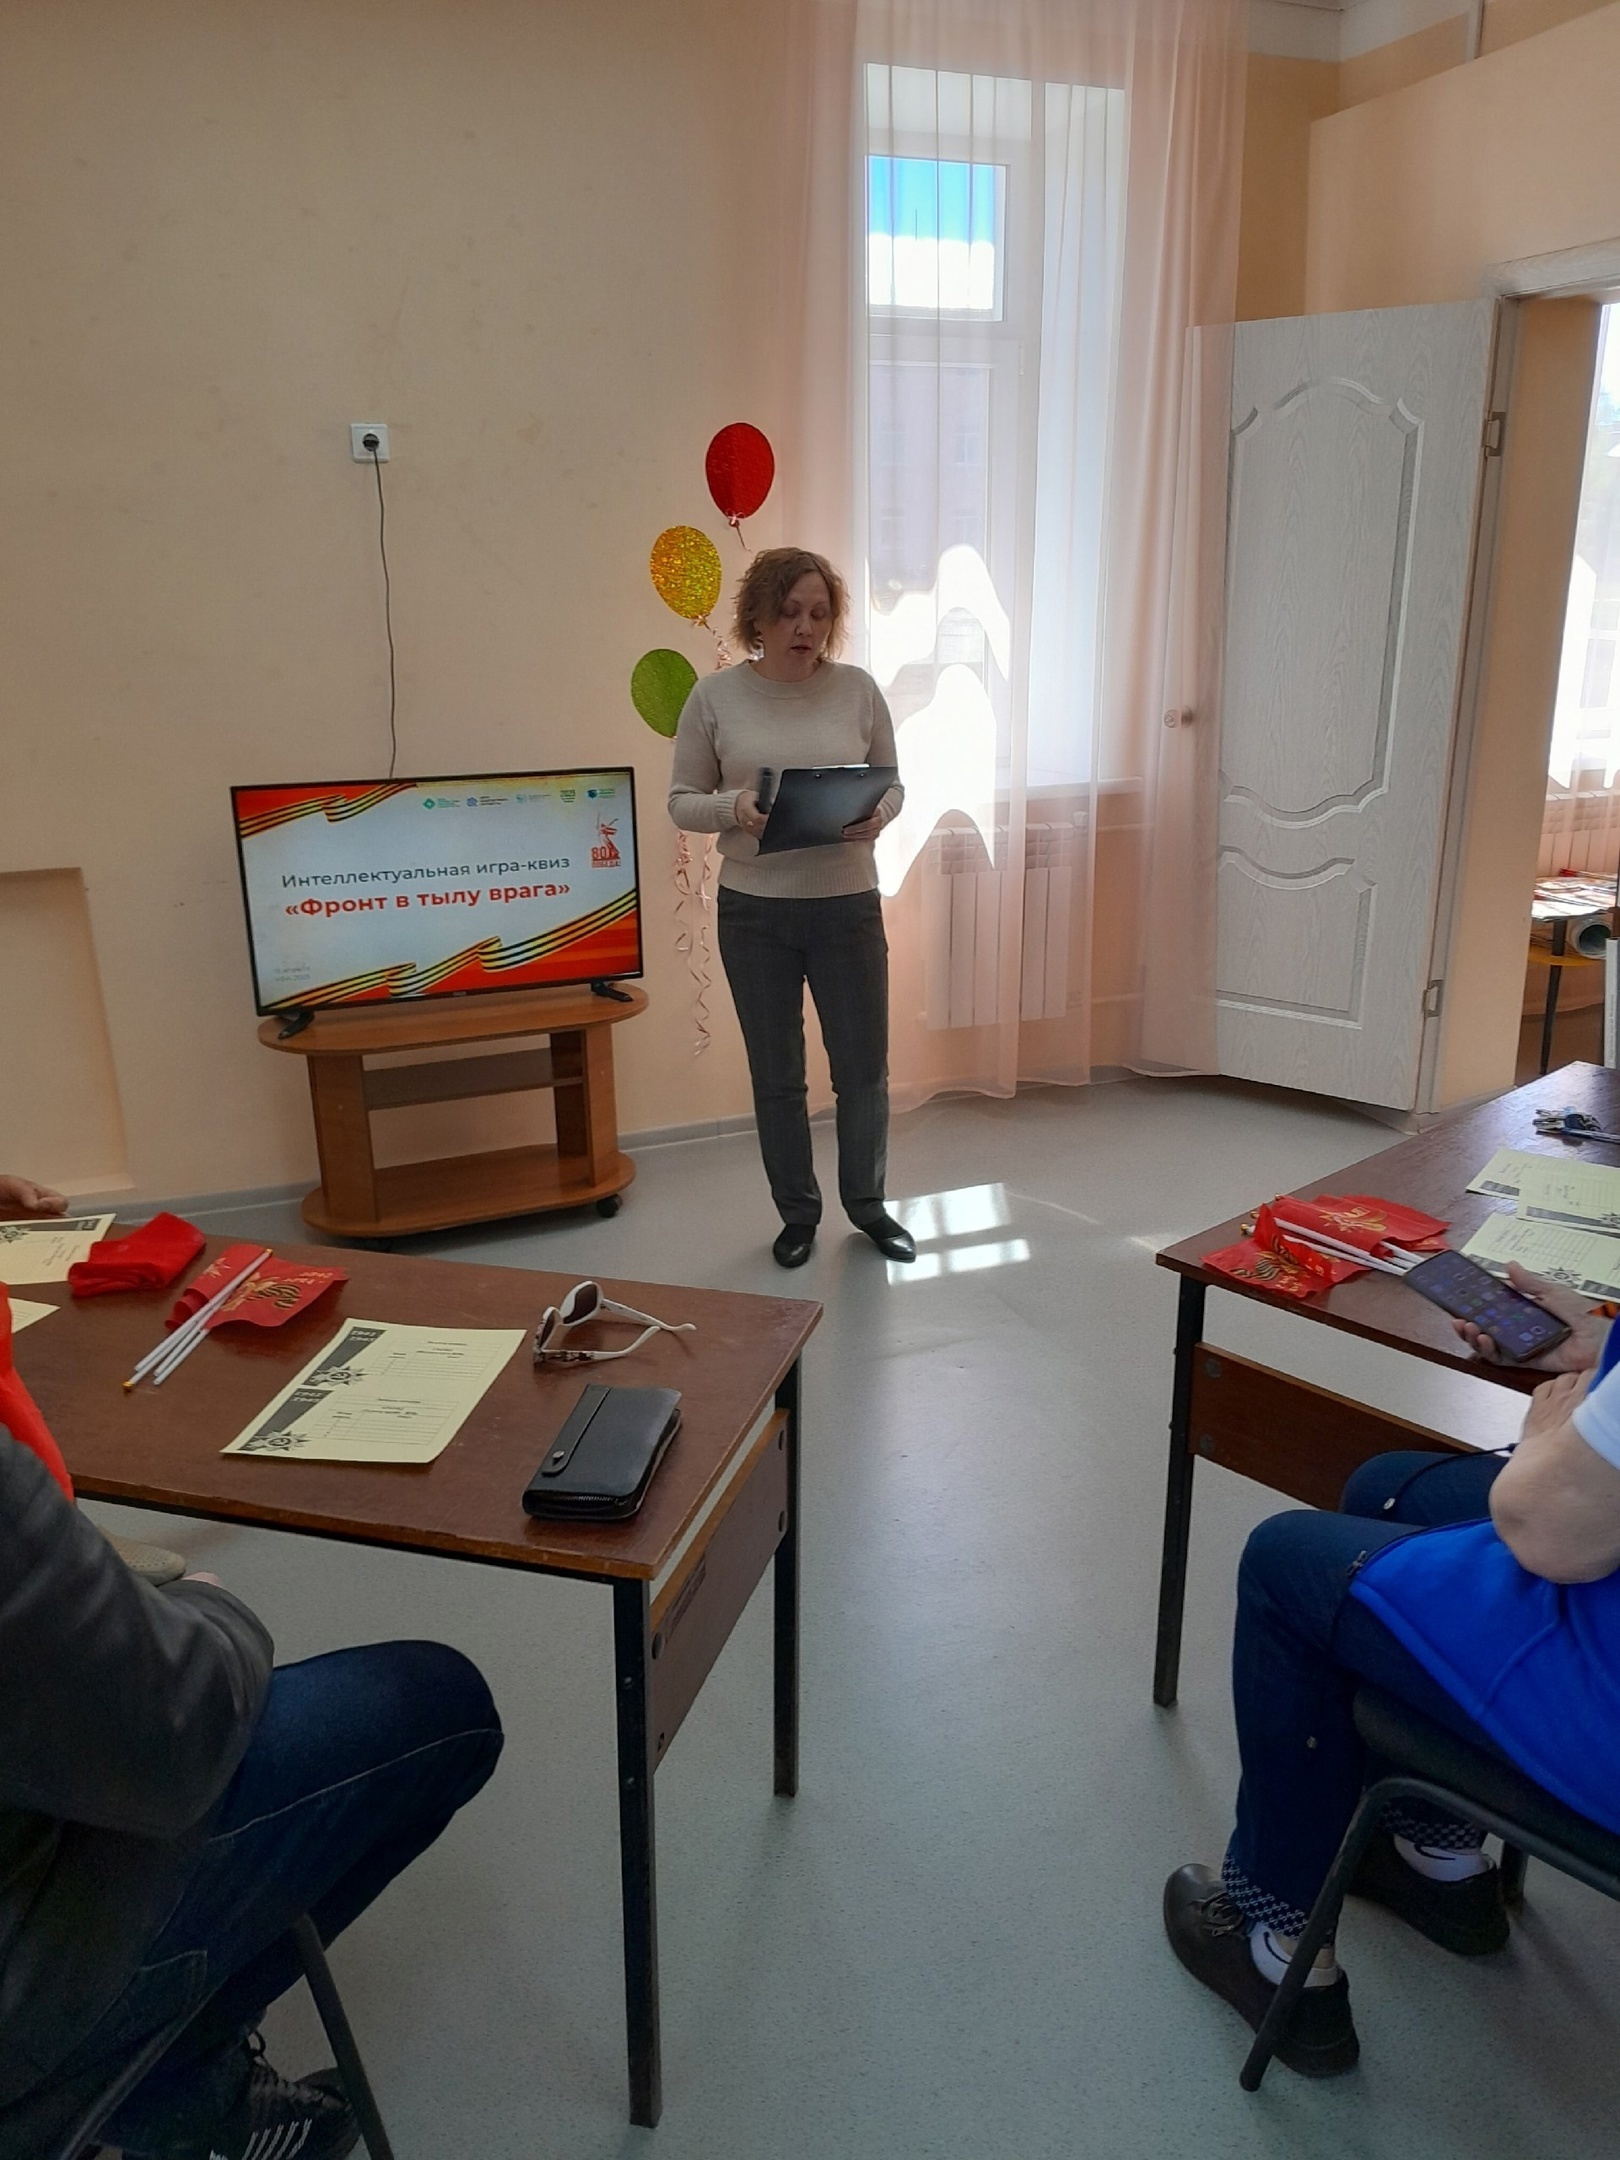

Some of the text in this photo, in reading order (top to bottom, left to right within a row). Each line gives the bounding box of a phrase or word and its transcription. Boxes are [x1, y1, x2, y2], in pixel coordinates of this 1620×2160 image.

[591, 846, 607, 860] 80
[282, 858, 570, 888] Интеллектуальная игра-квиз
[285, 883, 570, 918] «Фронт в тылу врага»
